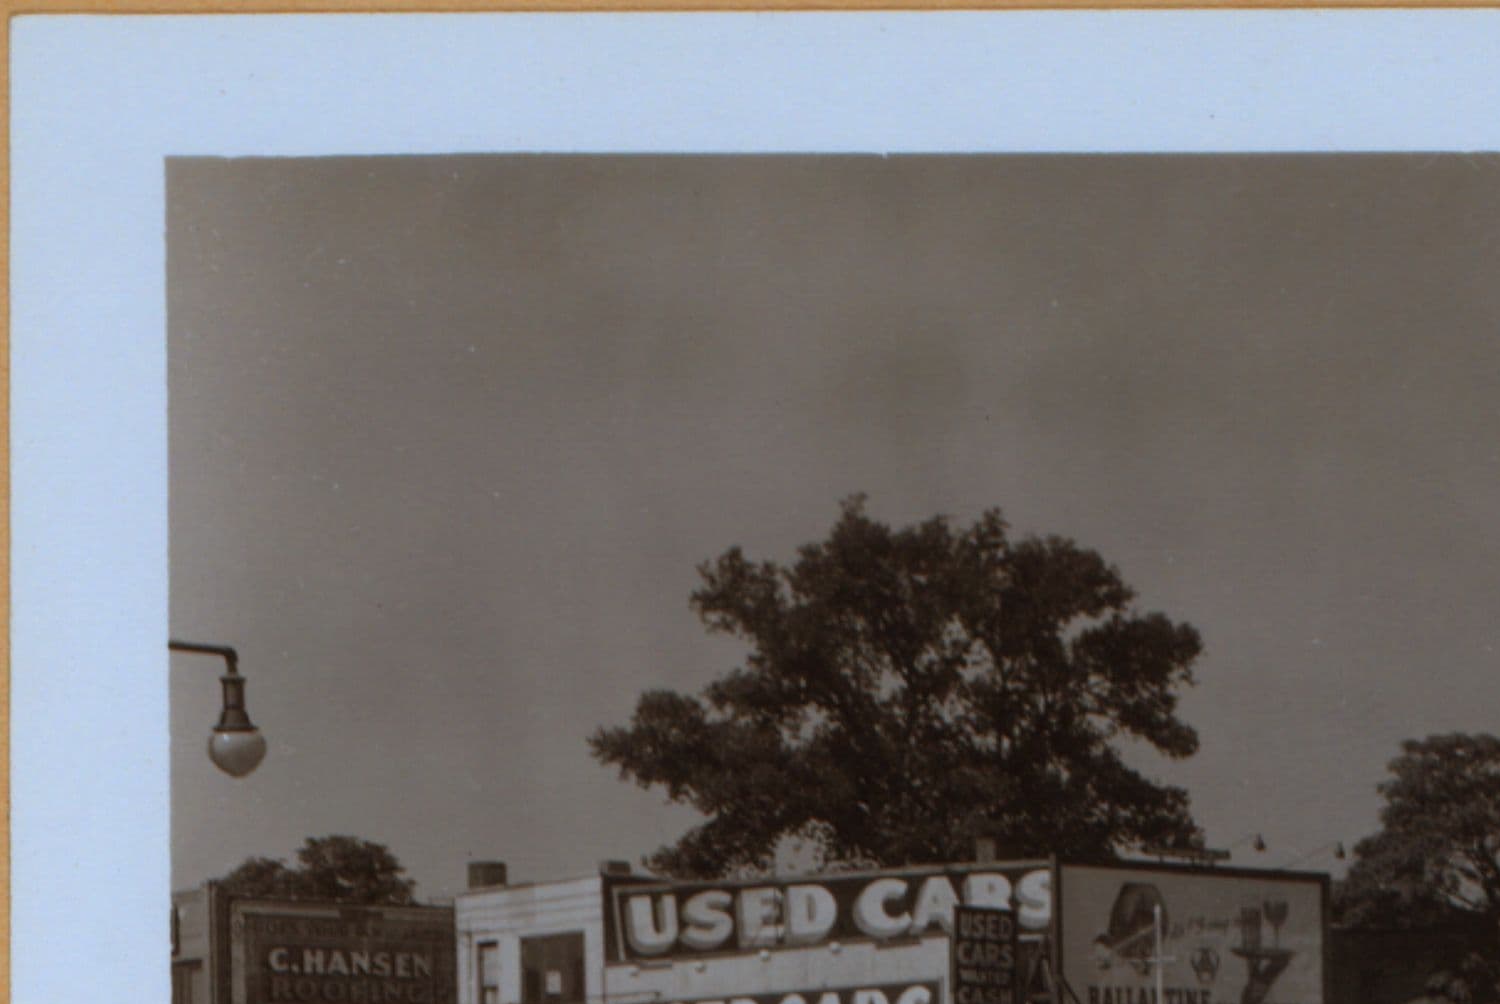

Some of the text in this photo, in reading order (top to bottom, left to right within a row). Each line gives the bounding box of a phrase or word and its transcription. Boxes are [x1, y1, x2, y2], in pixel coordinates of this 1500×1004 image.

[629, 872, 1051, 953] USED CARS
[960, 912, 1012, 939] USED
[303, 948, 431, 977] HANSEN
[958, 941, 1014, 968] CARS
[270, 975, 425, 1004] ROOFING
